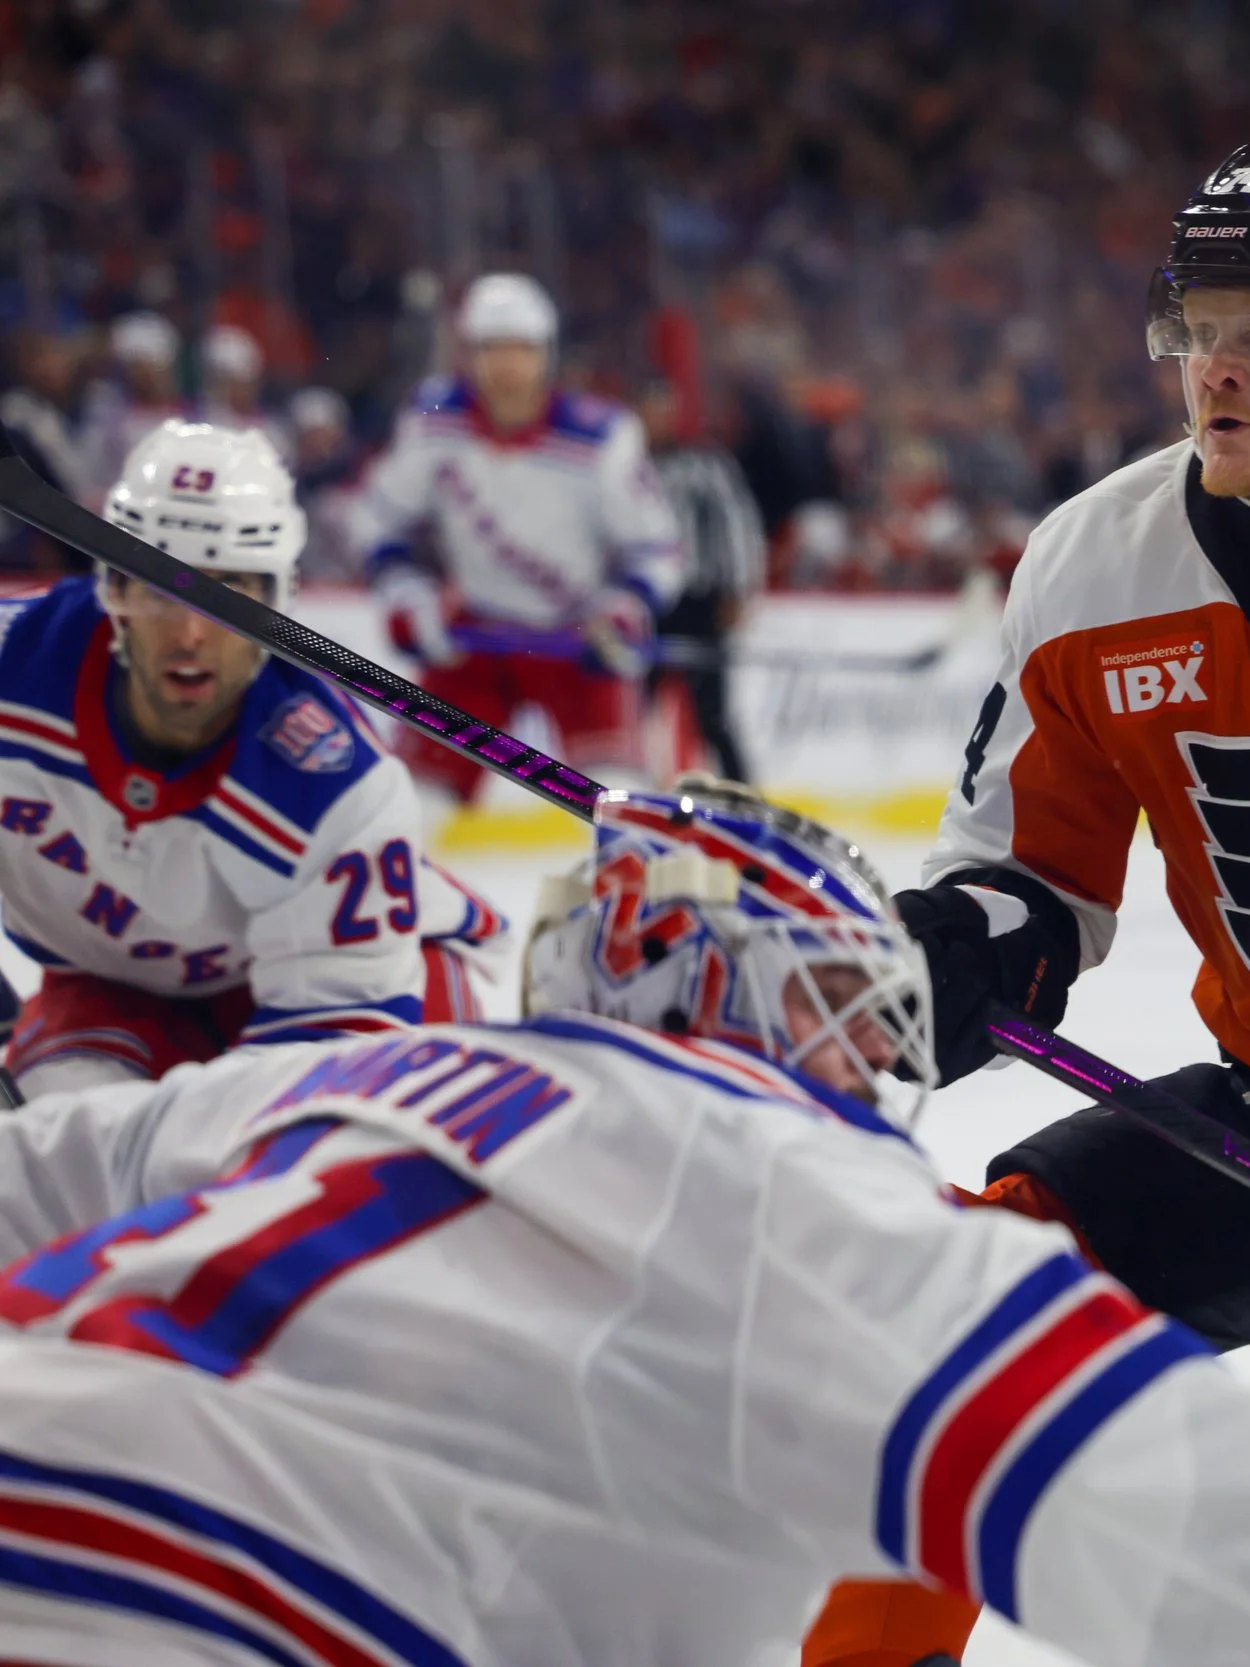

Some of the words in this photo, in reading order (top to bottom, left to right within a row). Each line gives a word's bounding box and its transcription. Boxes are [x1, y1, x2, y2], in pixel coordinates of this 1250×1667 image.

[1184, 226, 1248, 239] BAUER
[1100, 643, 1189, 667] Independence
[1103, 655, 1209, 715] IBX
[324, 836, 419, 947] 29
